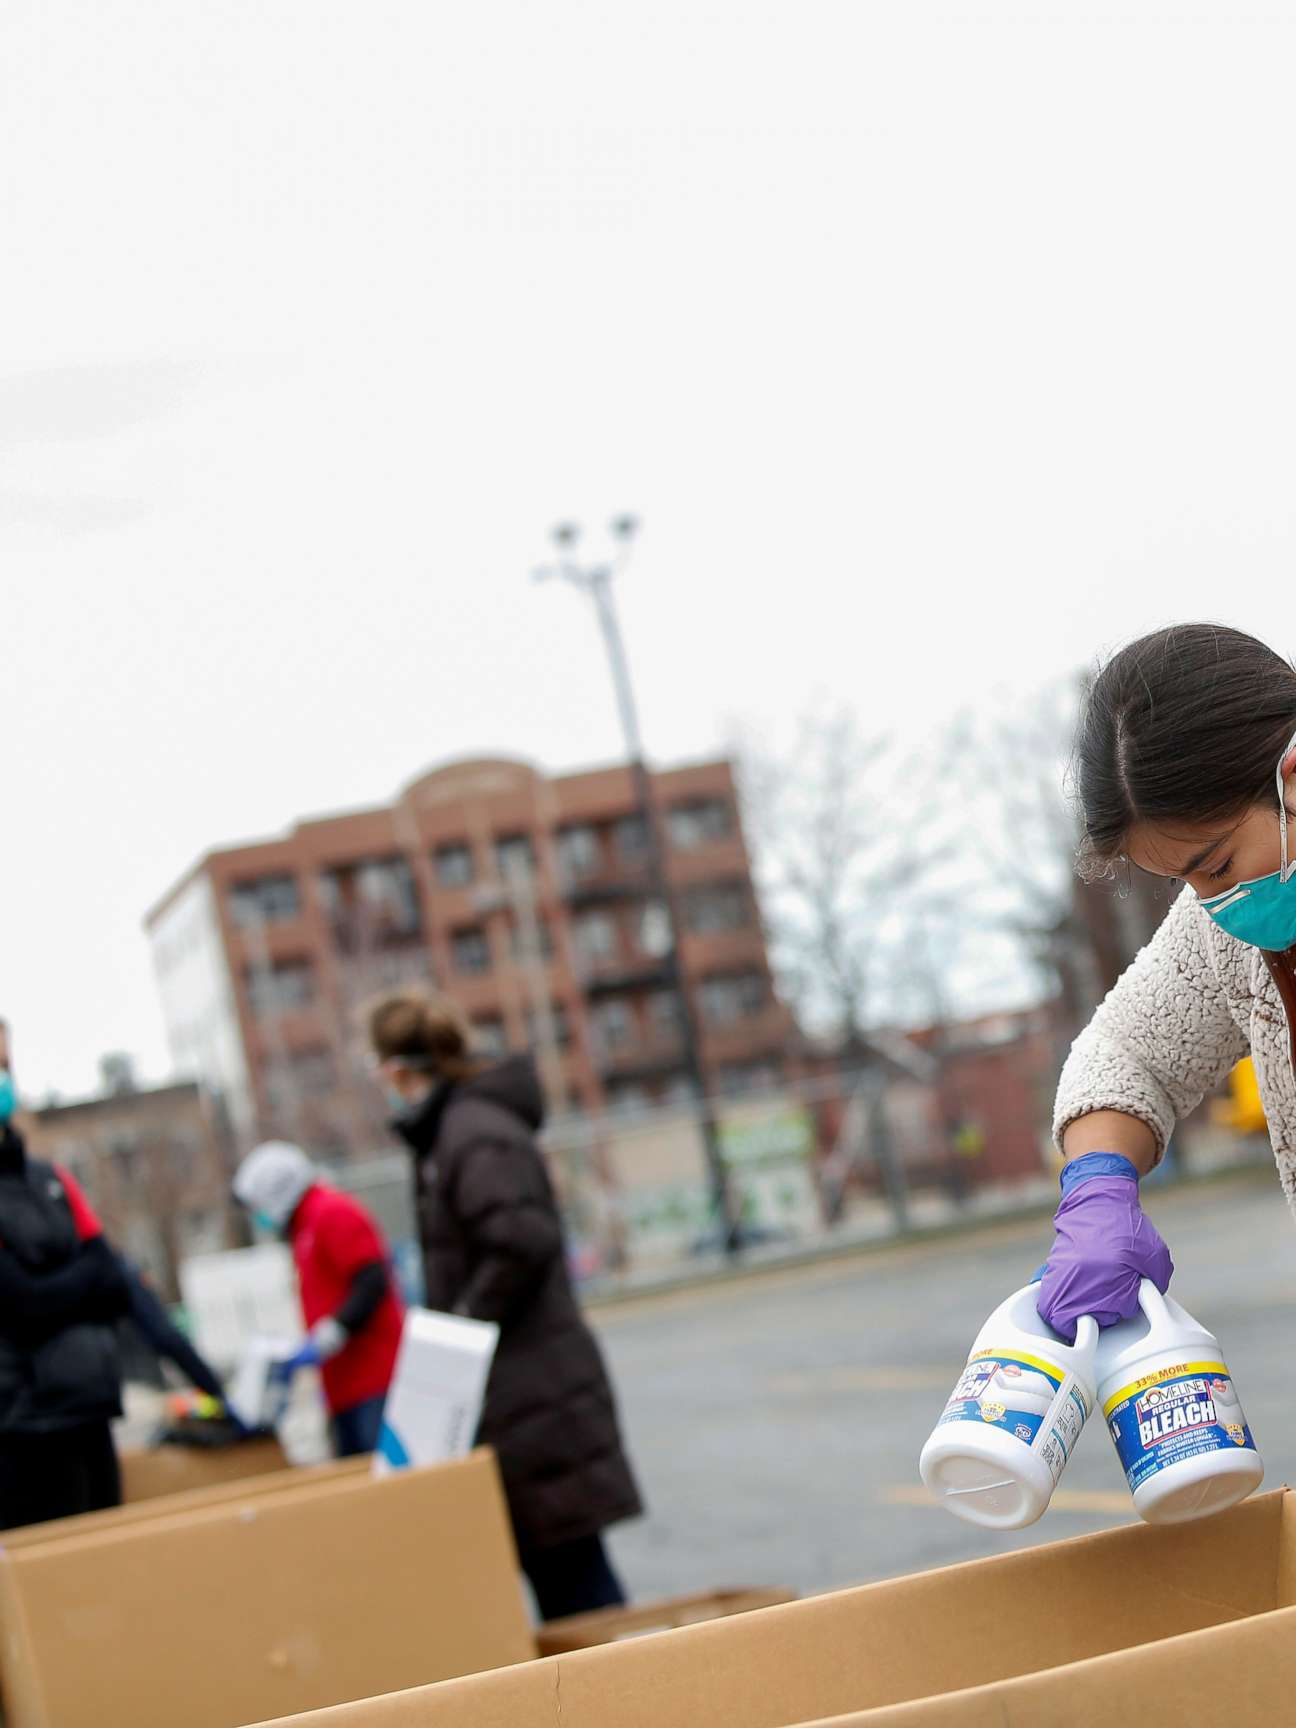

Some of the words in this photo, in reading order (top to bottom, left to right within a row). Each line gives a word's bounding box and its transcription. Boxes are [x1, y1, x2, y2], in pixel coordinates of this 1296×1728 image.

[1136, 1373, 1158, 1389] 33%
[1158, 1363, 1190, 1379] MORE
[1140, 1379, 1205, 1412] HOMELINE
[1152, 1395, 1196, 1416] REGULAR
[1140, 1401, 1216, 1446] BLEACH
